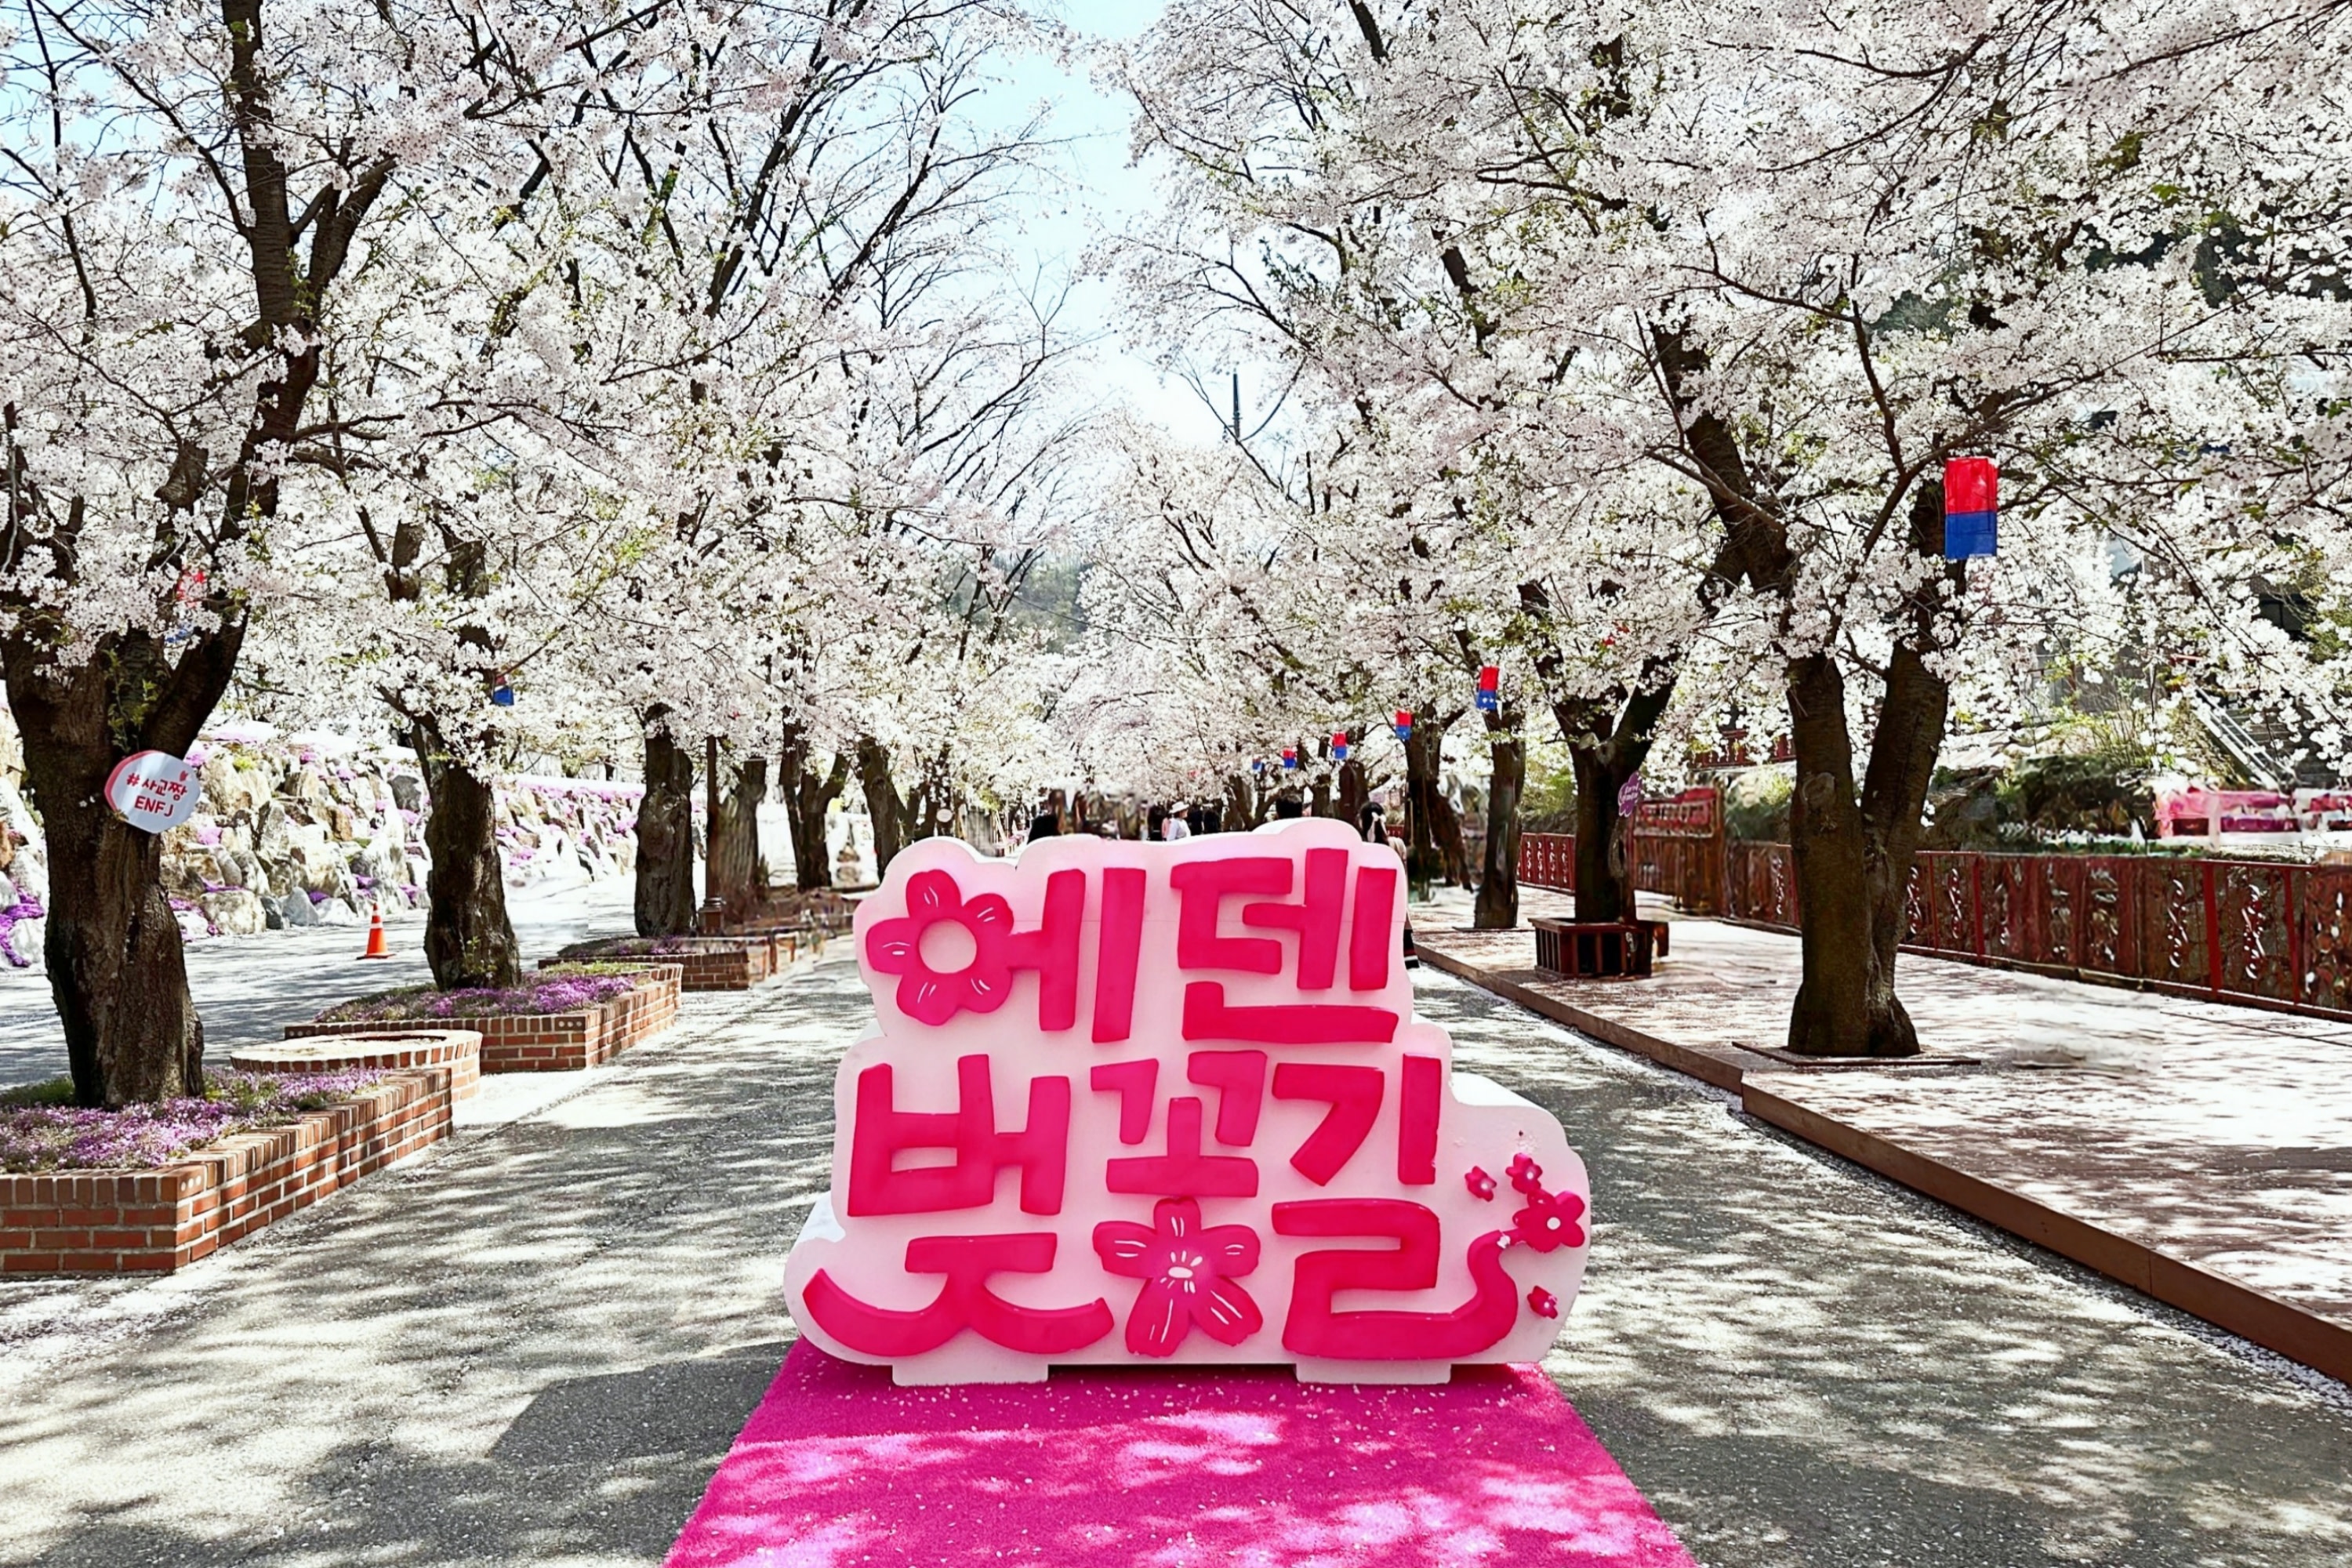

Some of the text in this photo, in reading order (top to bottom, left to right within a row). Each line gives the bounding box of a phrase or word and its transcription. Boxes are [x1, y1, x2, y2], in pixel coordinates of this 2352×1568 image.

[126, 772, 187, 801] #사교짱
[134, 795, 174, 817] ENFJ
[866, 848, 1399, 1044] 에덴
[801, 1050, 1518, 1360] 벚꽃길
